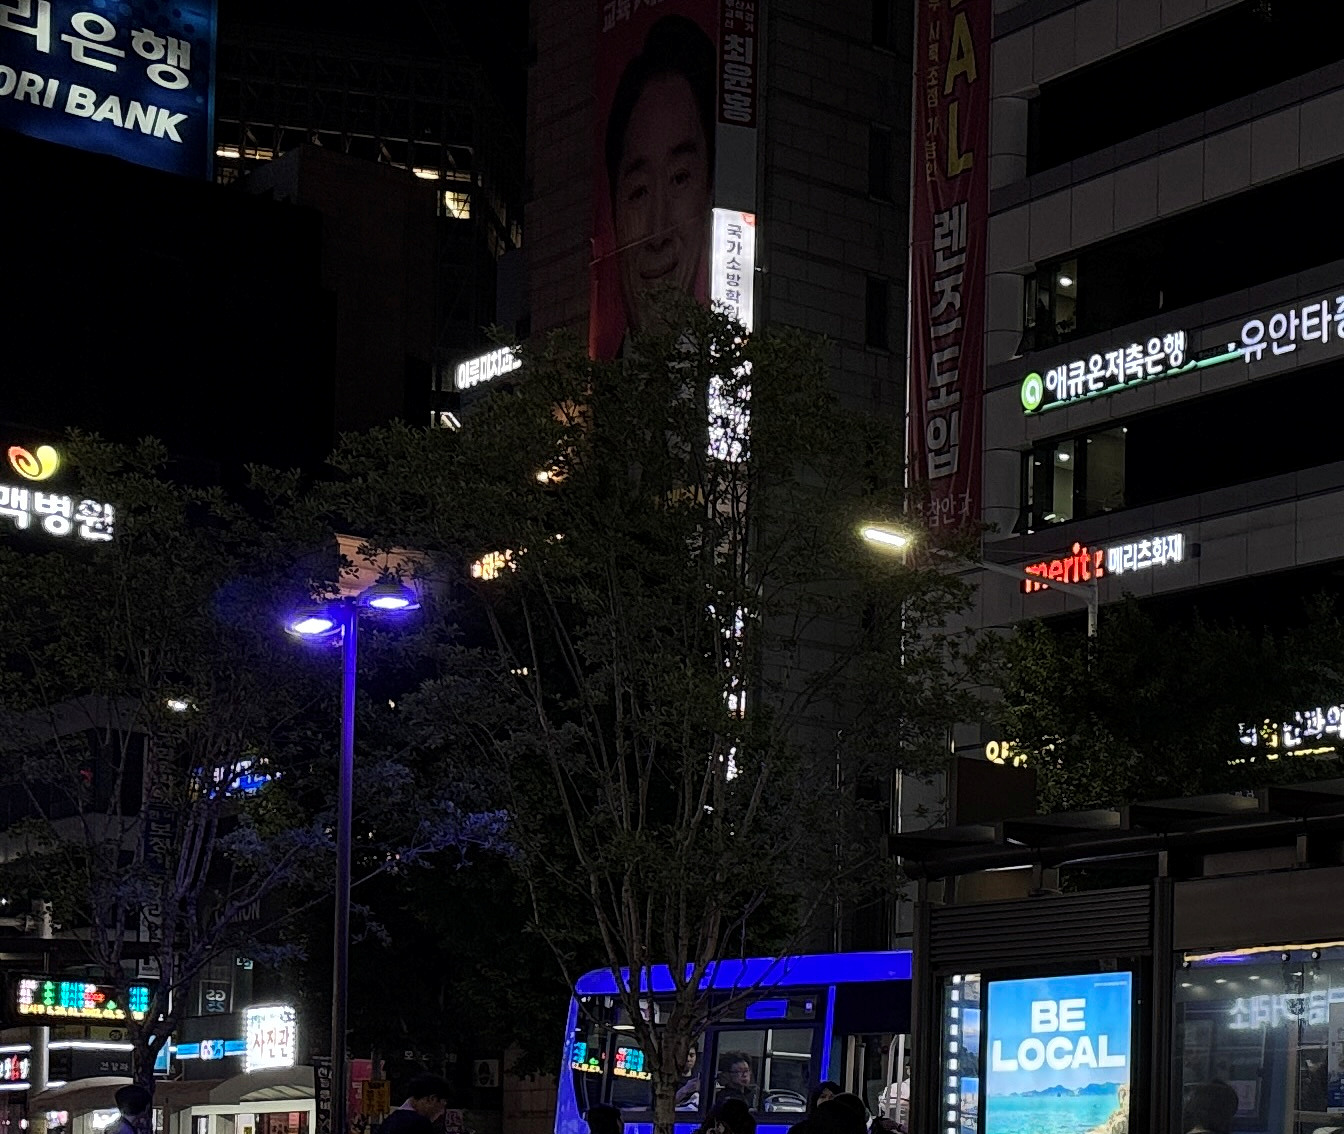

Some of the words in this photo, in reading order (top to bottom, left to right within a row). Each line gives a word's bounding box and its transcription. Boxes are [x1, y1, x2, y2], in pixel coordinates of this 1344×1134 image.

[722, 33, 755, 123] 최윤홍
[943, 0, 978, 178] AL
[65, 82, 188, 145] BANK
[926, 200, 968, 480] 렌즈도입
[1046, 328, 1187, 402] 애큐온저축은행
[1107, 532, 1184, 575] 메리츠화재
[253, 1026, 290, 1058] 사진관
[1031, 998, 1086, 1033] BE
[992, 1036, 1126, 1072] LOCAL
